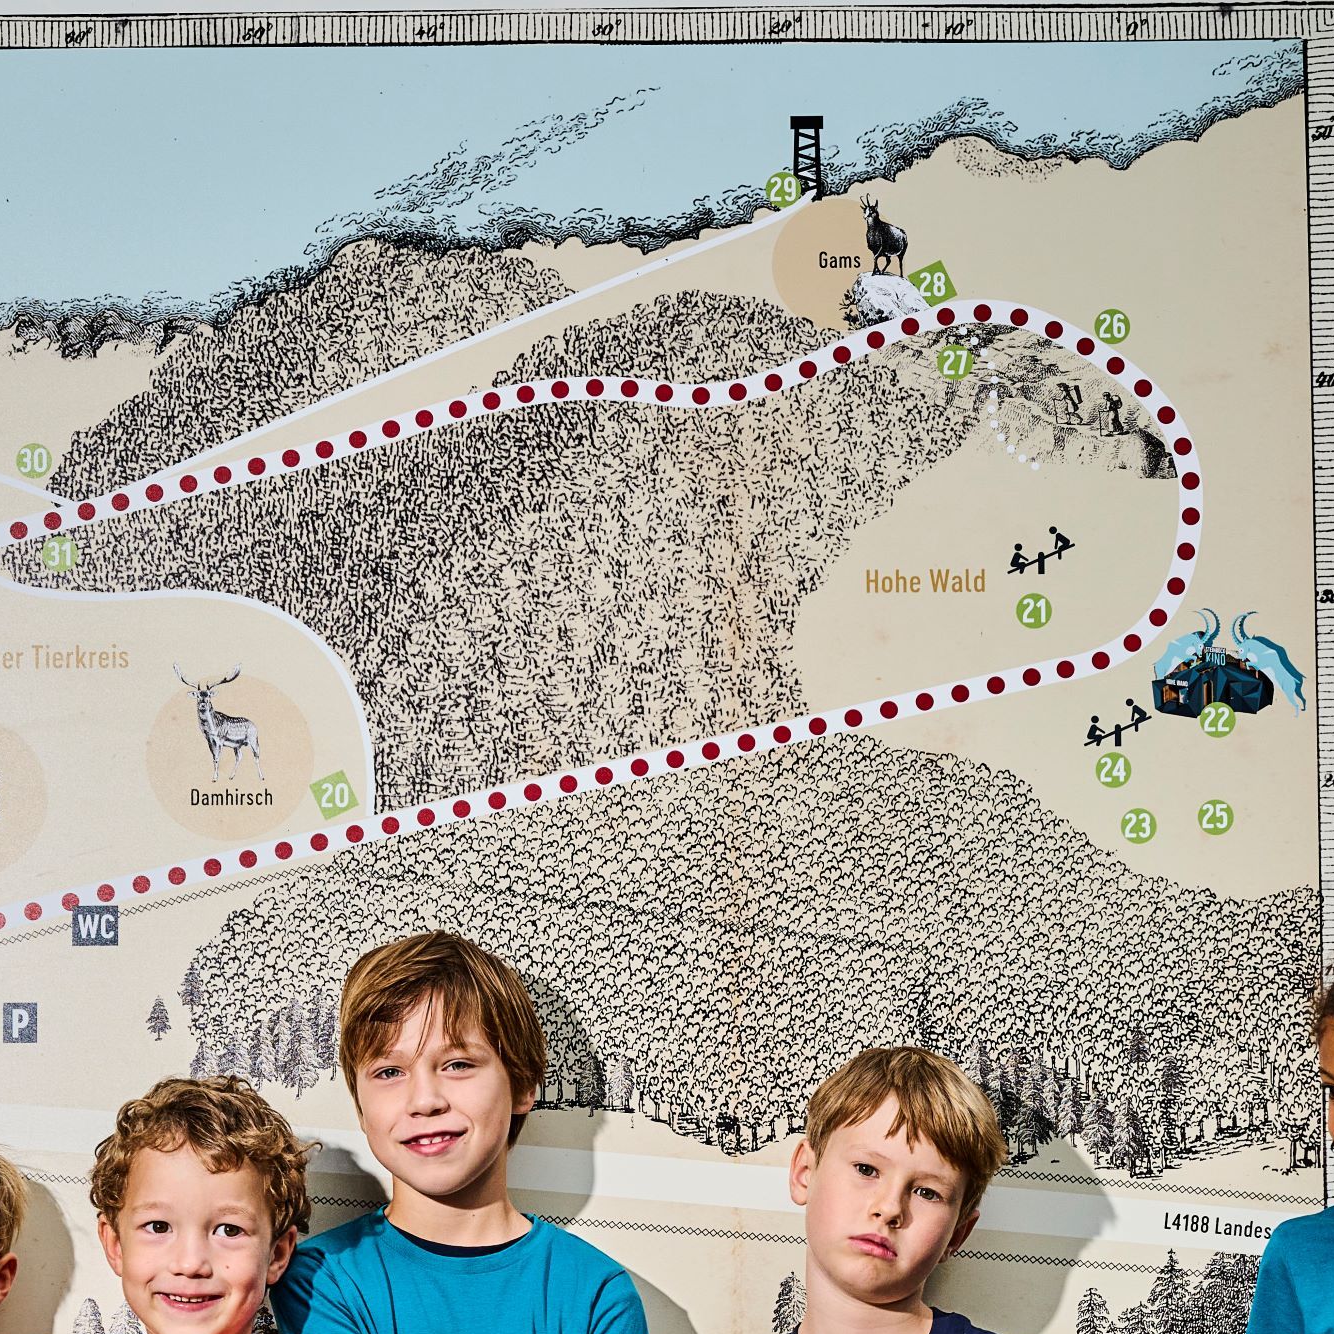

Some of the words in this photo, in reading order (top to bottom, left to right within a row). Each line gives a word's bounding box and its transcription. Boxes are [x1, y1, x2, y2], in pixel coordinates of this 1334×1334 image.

[770, 177, 798, 201] 29
[819, 251, 861, 270] Gams
[919, 272, 946, 297] 28
[1100, 313, 1126, 338] 26
[943, 350, 968, 375] 27
[20, 449, 47, 473] 30
[48, 542, 72, 565] 31
[866, 569, 922, 594] Hohe
[930, 569, 986, 594] Wald
[1022, 599, 1047, 623] 21
[32, 644, 130, 670] Tierkreis
[1203, 707, 1230, 733] 22
[1100, 758, 1127, 782] 24
[190, 789, 273, 807] Damhirsch
[321, 783, 348, 808] 20
[1125, 814, 1151, 838] 23
[1203, 806, 1229, 830] 25
[77, 915, 114, 939] WC
[12, 1010, 29, 1037] P
[1164, 1211, 1209, 1233] L4188
